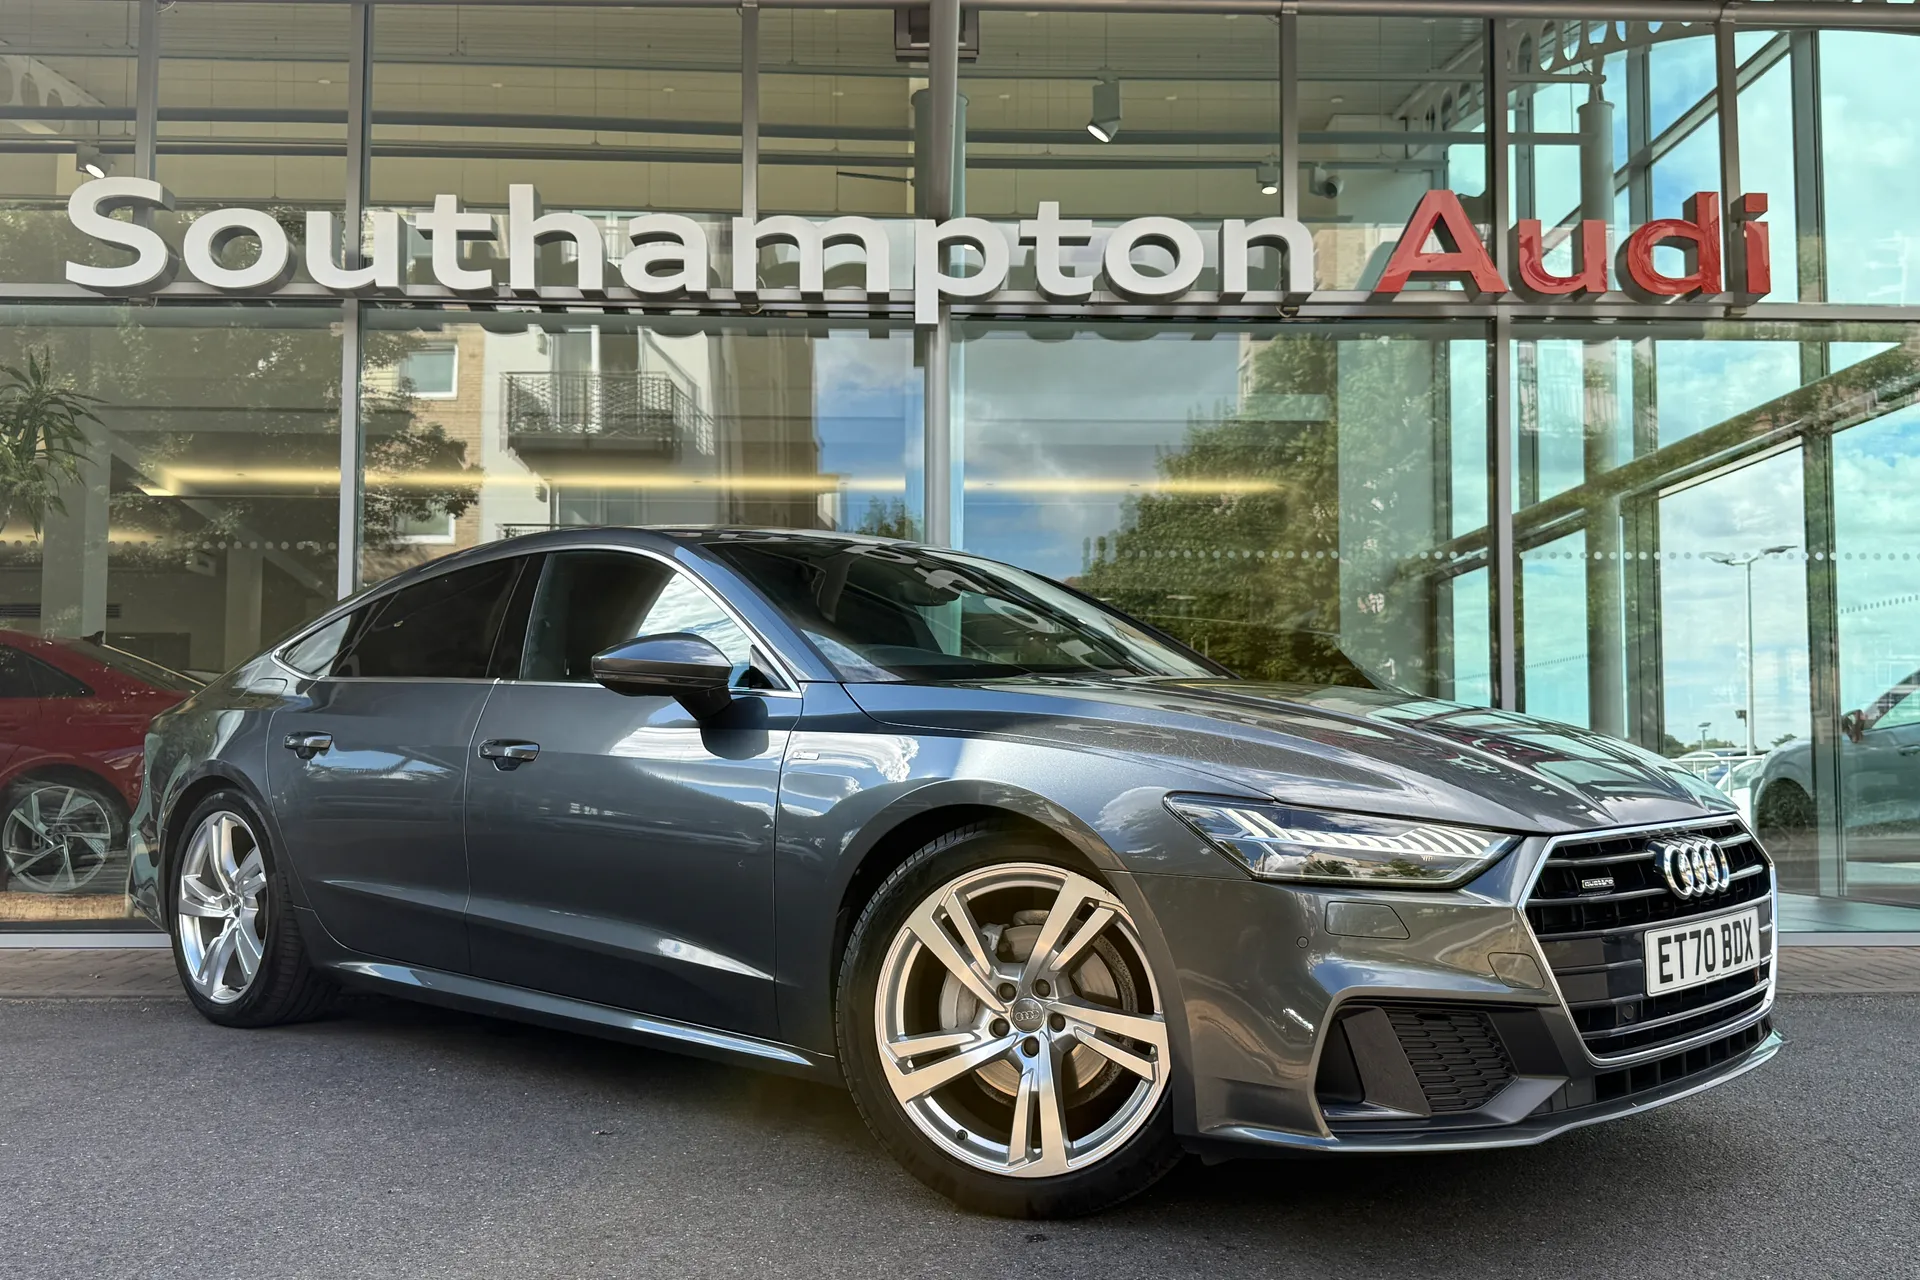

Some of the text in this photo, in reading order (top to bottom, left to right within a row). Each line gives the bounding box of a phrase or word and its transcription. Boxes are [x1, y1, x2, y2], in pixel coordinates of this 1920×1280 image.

[65, 176, 1771, 324] Southampton Audi
[1657, 917, 1754, 984] ET70 BDX
